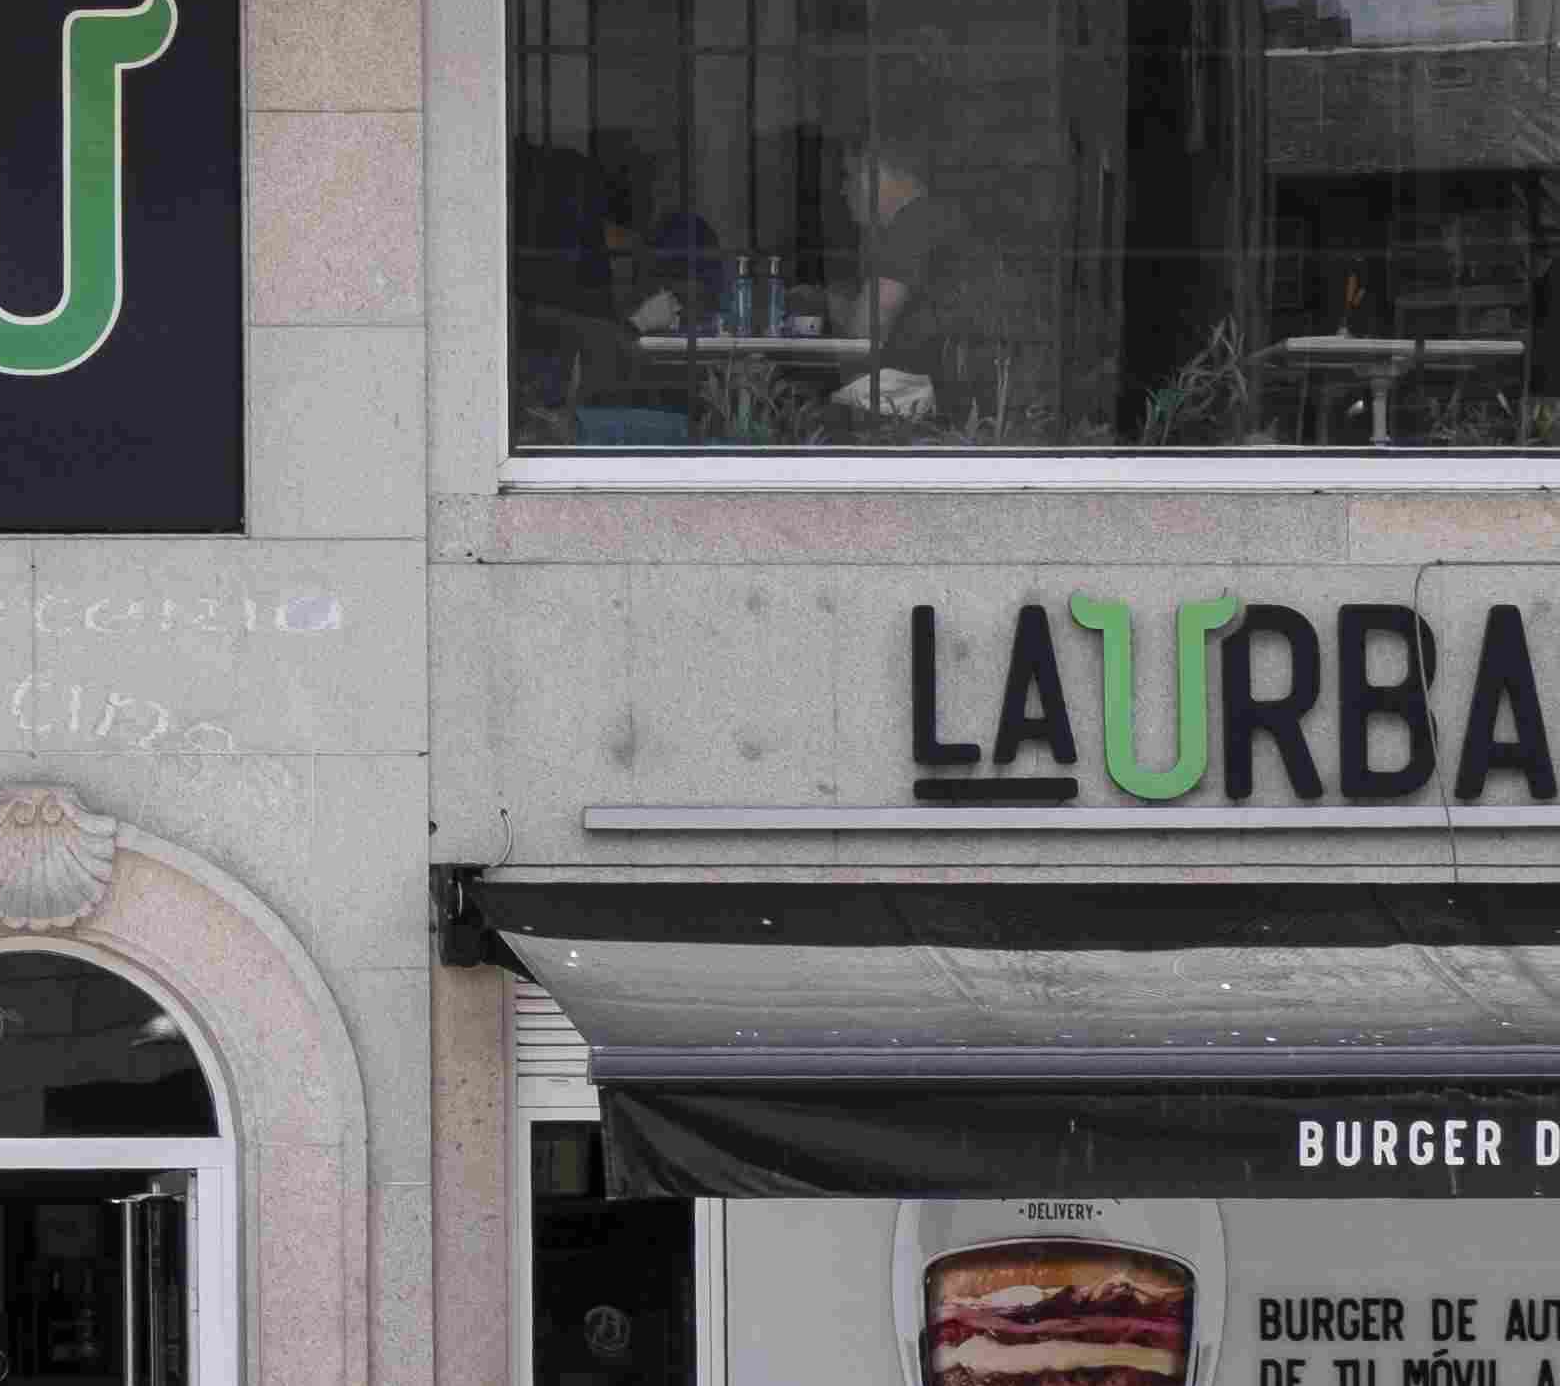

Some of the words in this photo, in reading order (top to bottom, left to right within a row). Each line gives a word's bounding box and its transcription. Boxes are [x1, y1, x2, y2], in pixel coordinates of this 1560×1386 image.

[1298, 1119, 1503, 1167] BURGER
[1027, 1203, 1094, 1220] DELIVERY
[1259, 1298, 1405, 1342] BURGER
[1431, 1298, 1478, 1342] DE
